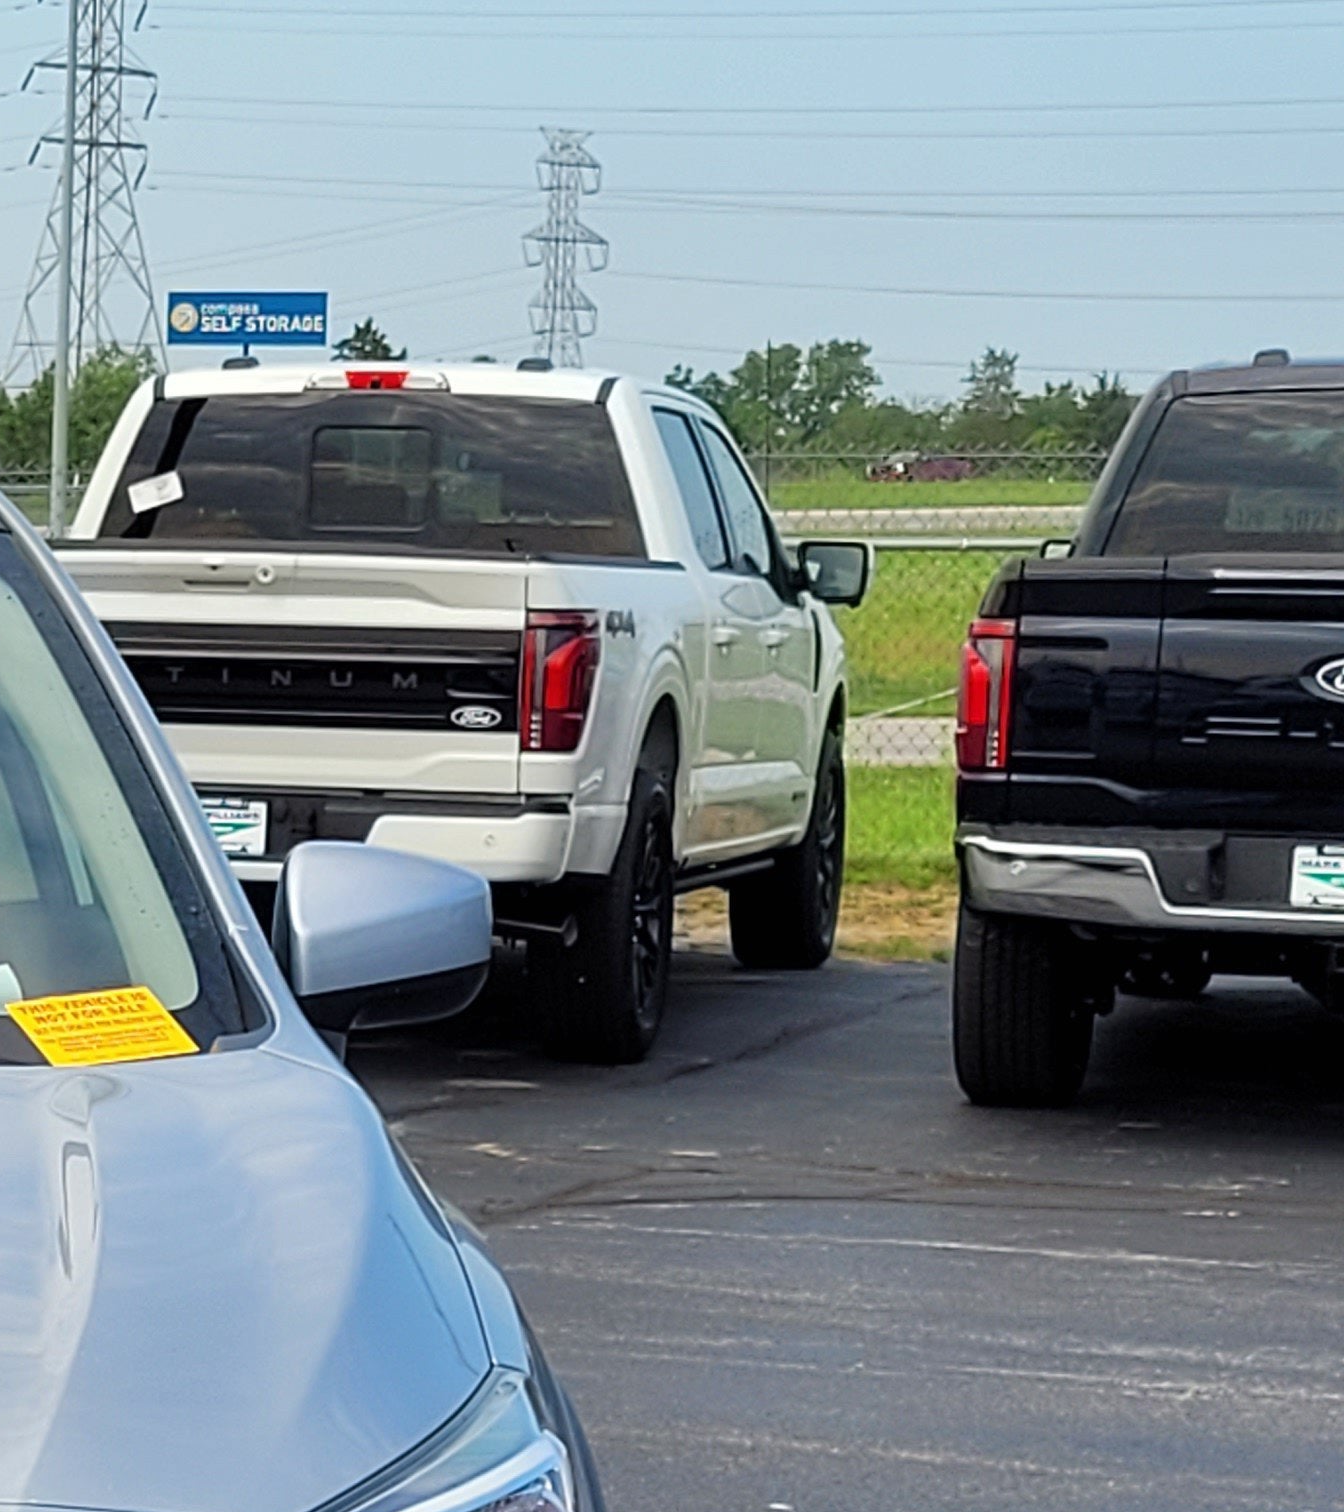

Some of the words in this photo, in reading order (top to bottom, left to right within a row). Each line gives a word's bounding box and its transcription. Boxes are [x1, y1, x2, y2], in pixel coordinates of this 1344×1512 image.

[200, 316, 241, 332] SELF
[245, 316, 324, 332] STORAGE
[166, 667, 418, 689] TINUM
[17, 1003, 56, 1014] THIS
[63, 994, 126, 1009] VEHICLE
[131, 992, 148, 1002] IS
[34, 1012, 67, 1025] NOT
[71, 1008, 105, 1020] FOR
[107, 1003, 147, 1016] SALE
